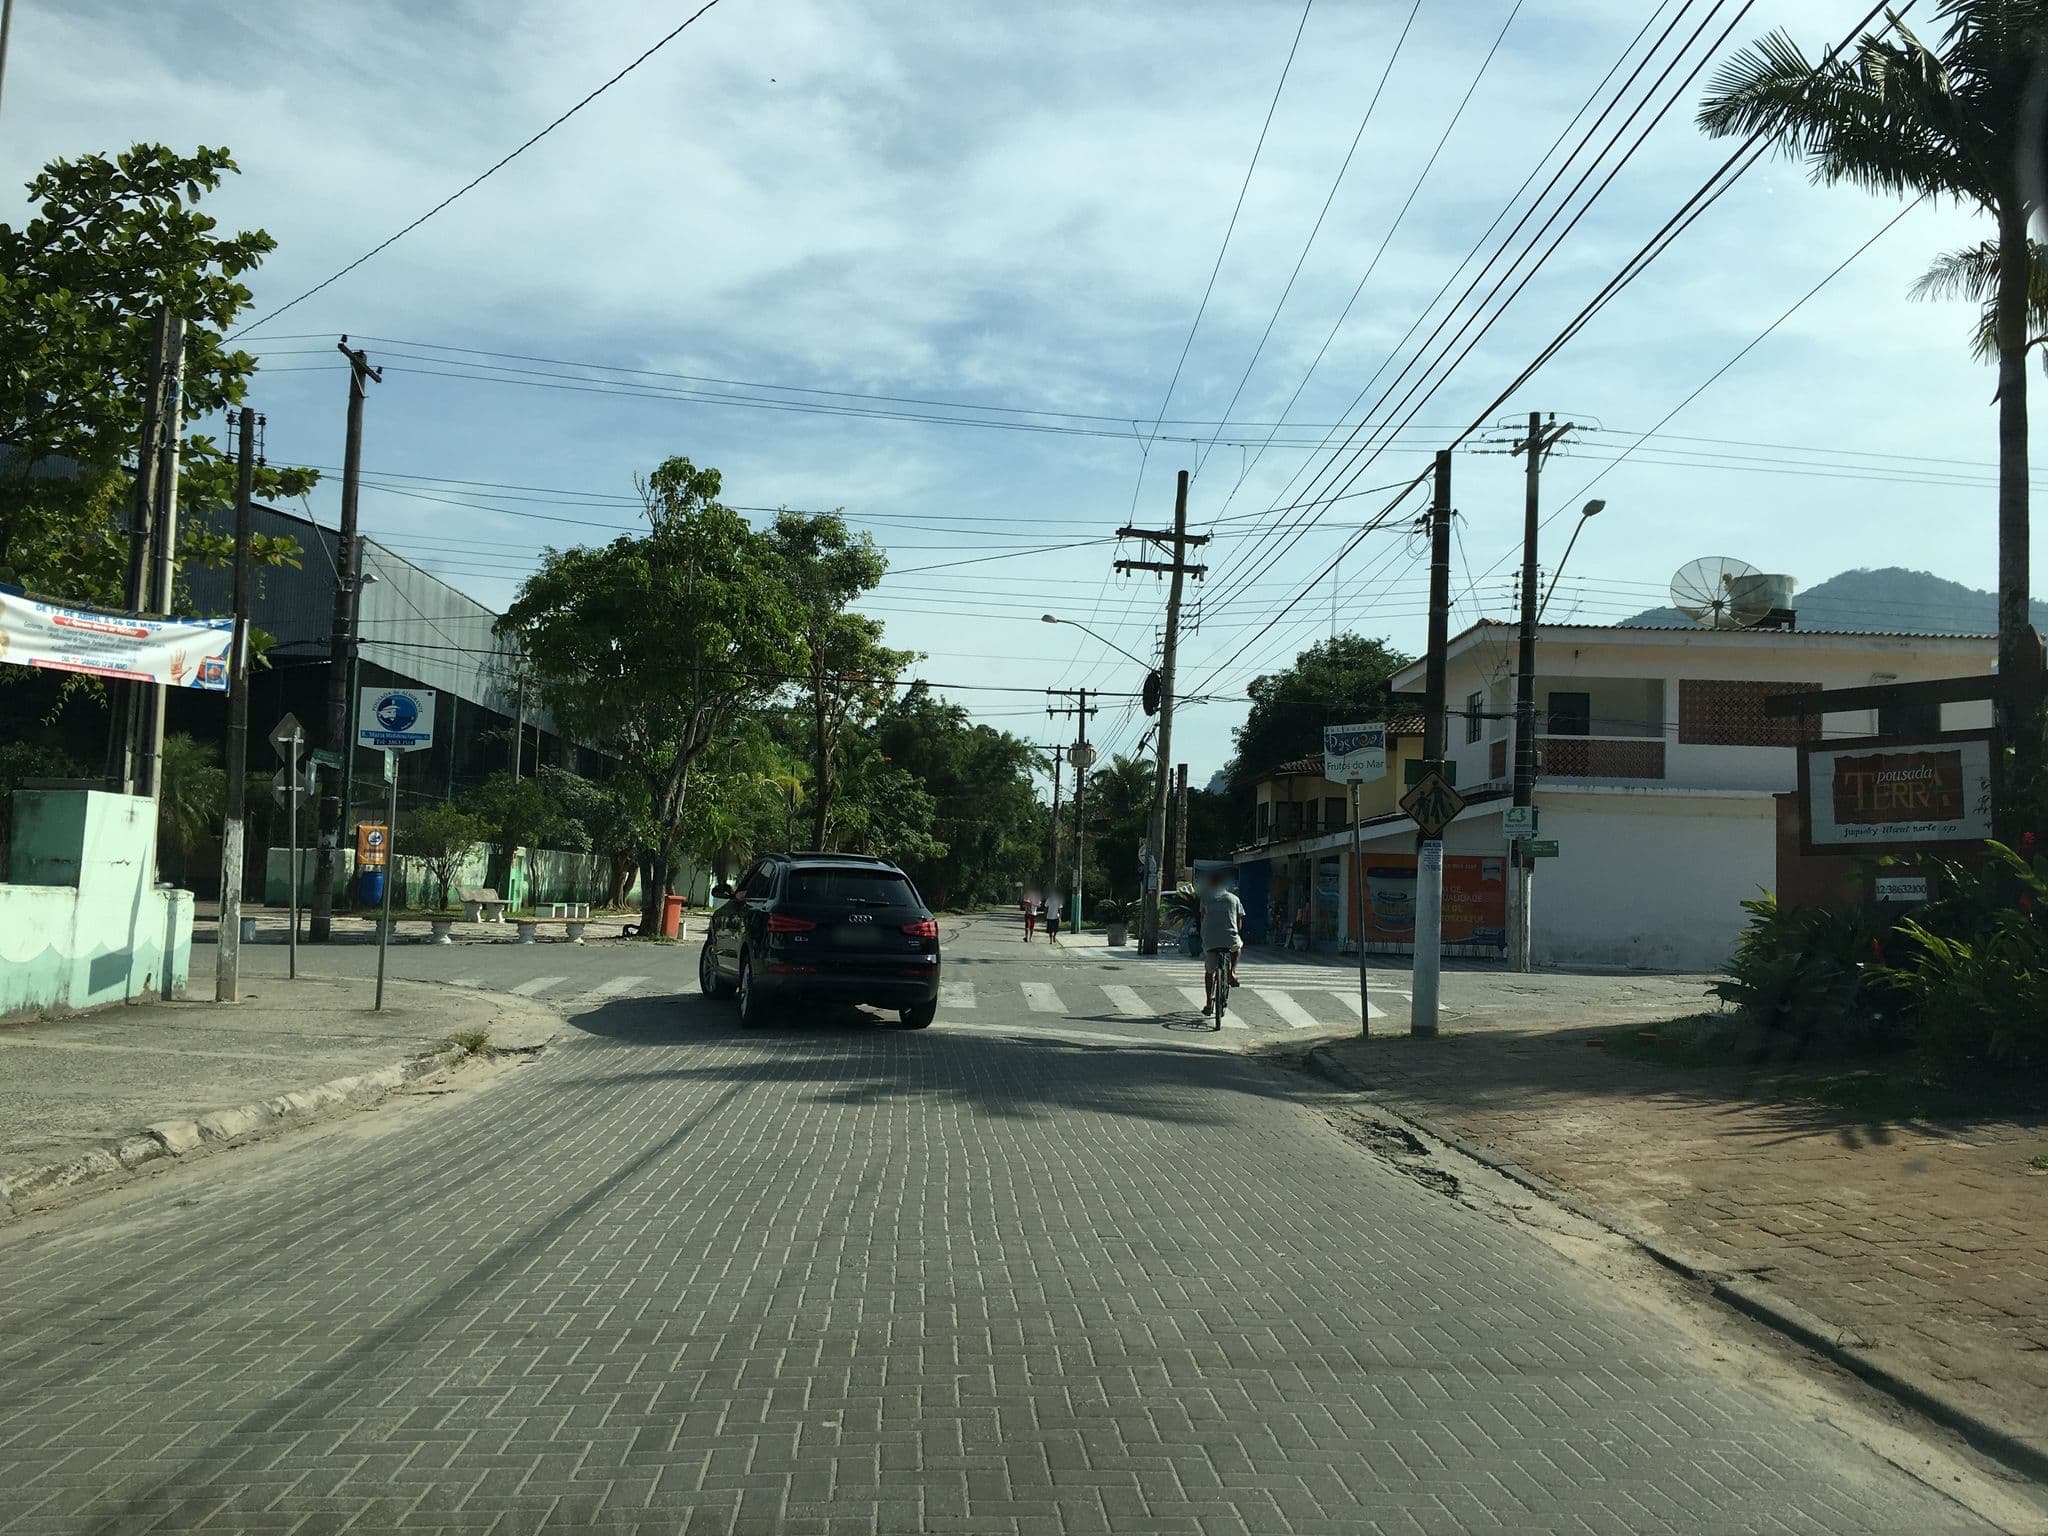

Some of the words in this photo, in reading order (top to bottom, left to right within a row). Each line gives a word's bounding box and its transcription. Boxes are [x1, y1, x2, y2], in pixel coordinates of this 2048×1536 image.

[1327, 761, 1351, 771] Frutos
[1352, 760, 1364, 769] do
[1366, 759, 1384, 769] Mar
[1876, 764, 1933, 784] pousada
